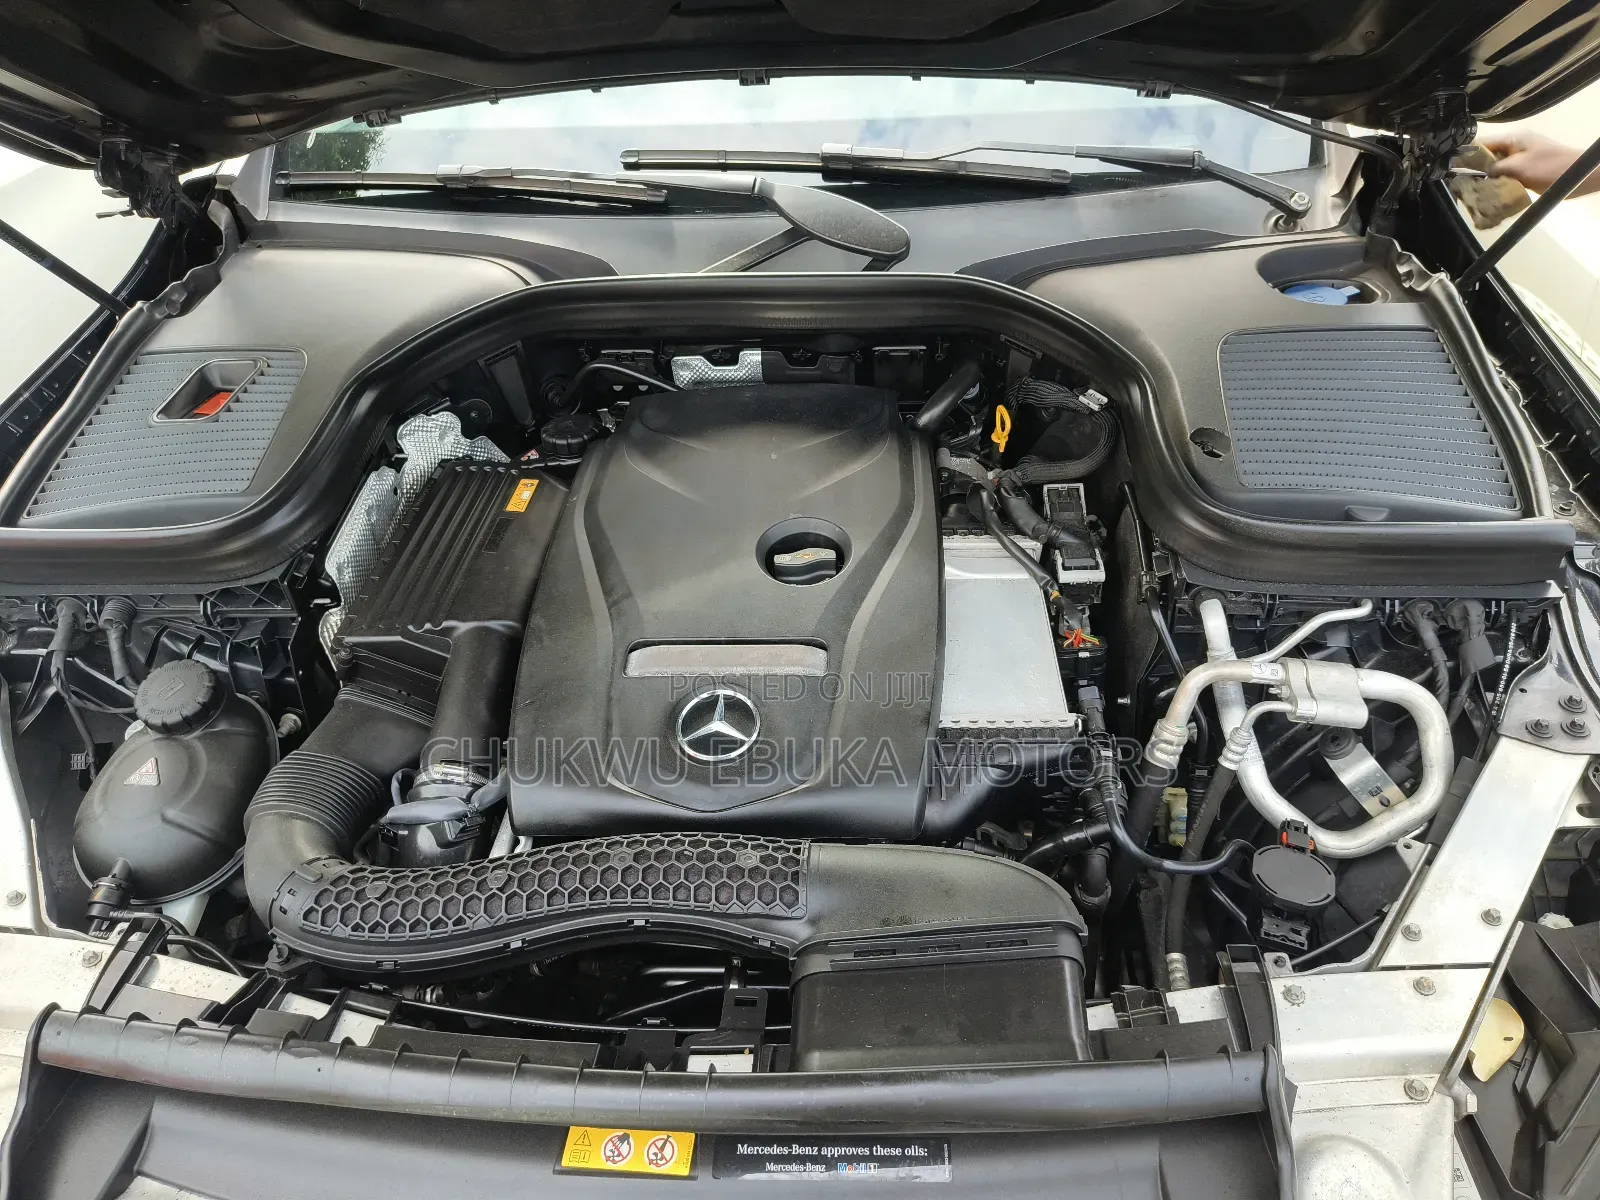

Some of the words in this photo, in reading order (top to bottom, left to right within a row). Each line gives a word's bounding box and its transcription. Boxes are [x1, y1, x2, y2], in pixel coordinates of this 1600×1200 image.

[736, 1143, 818, 1156] Mercedes-Benz
[821, 1145, 870, 1158] approves
[873, 1145, 902, 1156] these
[905, 1145, 928, 1157] oils:
[765, 1162, 826, 1173] Mercedes-Benz
[837, 1162, 867, 1174] Mobil
